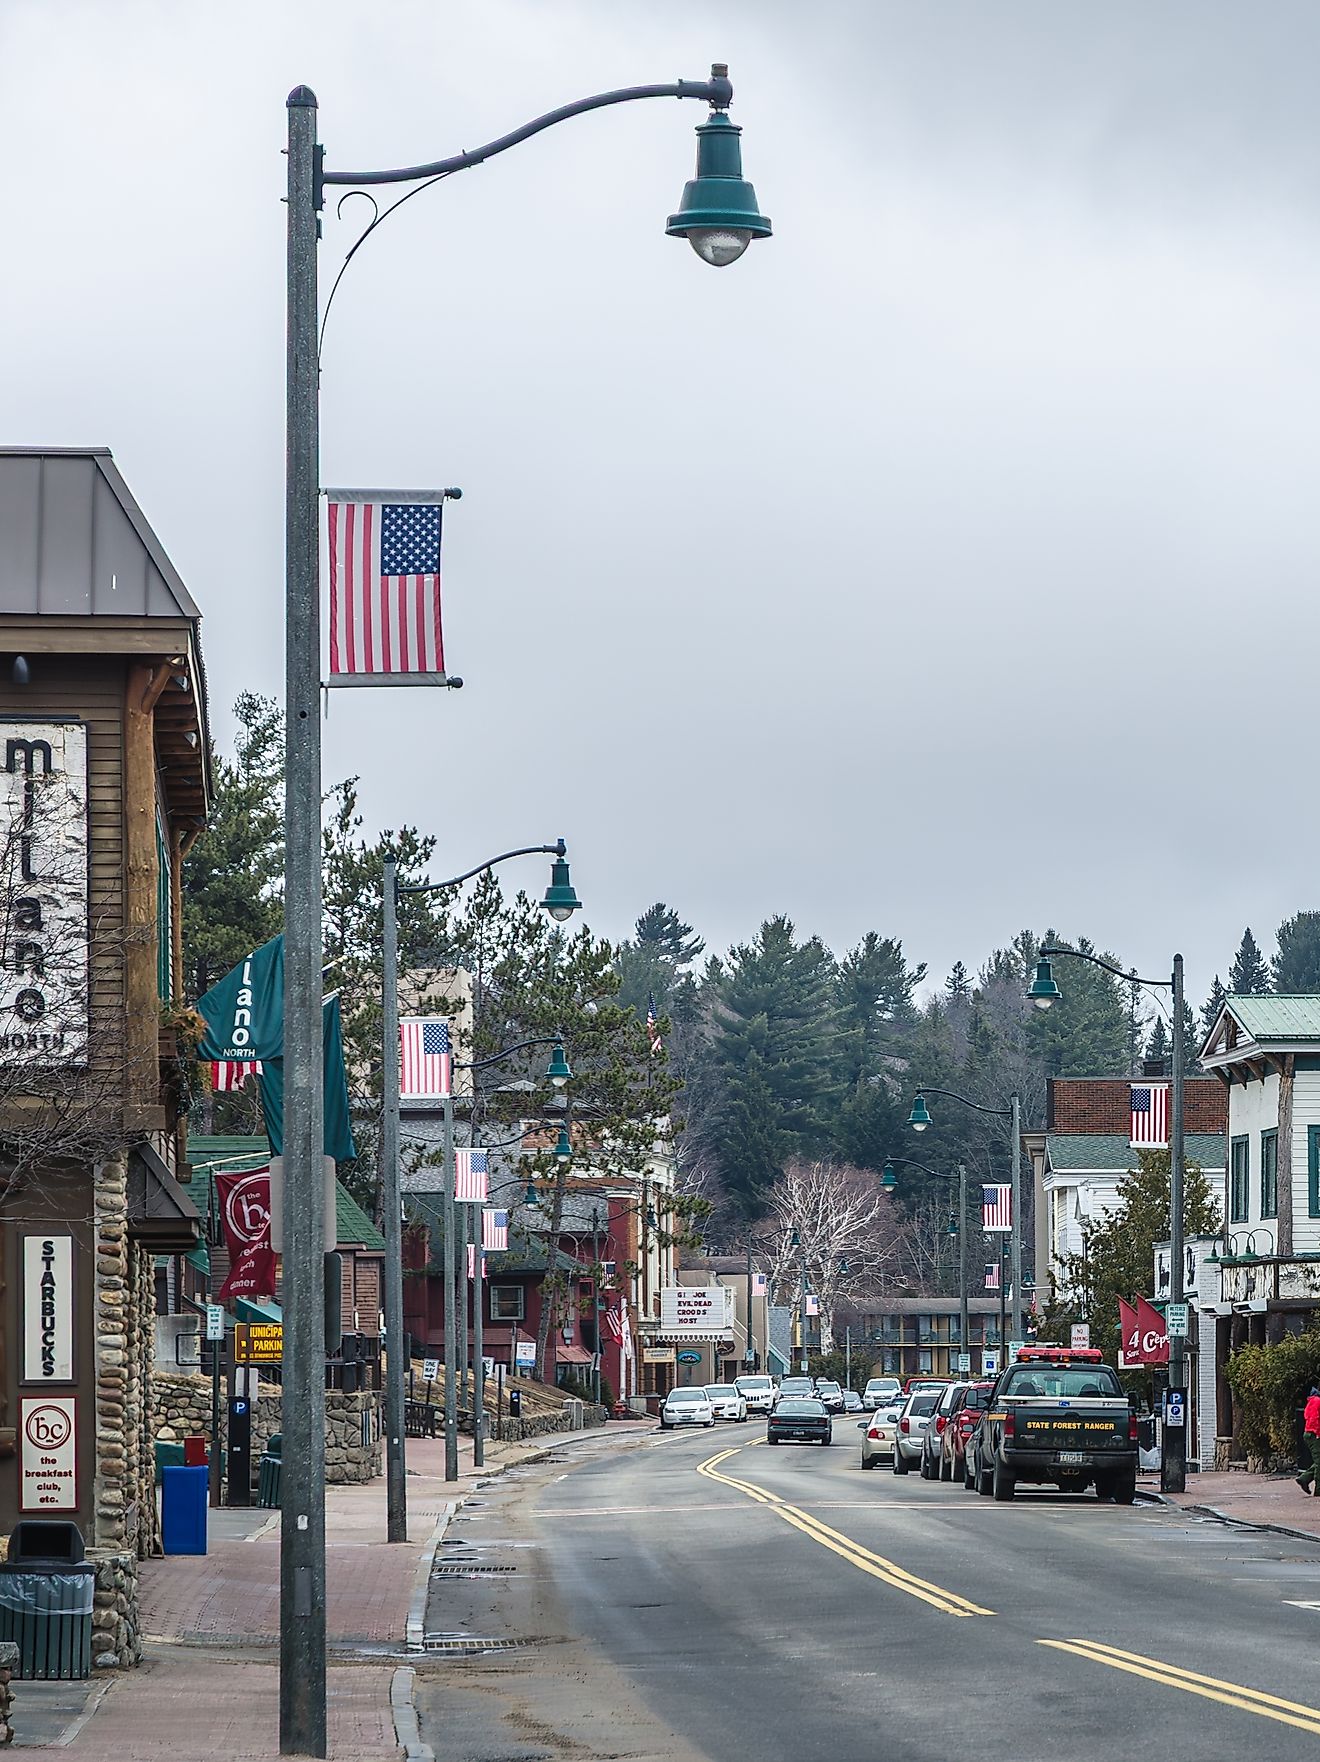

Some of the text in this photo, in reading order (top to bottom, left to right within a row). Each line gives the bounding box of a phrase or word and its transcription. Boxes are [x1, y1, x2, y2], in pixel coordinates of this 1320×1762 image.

[232, 953, 253, 1047] lano
[223, 1048, 256, 1057] NORTH
[40, 1240, 56, 1377] STARBUCKS
[249, 1326, 282, 1338] UNICIPA
[253, 1340, 282, 1351] PARKIN
[1171, 1393, 1181, 1403] P
[236, 1402, 246, 1414] P
[40, 1456, 57, 1465] the
[25, 1469, 73, 1478] breakfast
[36, 1482, 61, 1492] club,
[39, 1495, 59, 1503] etc.
